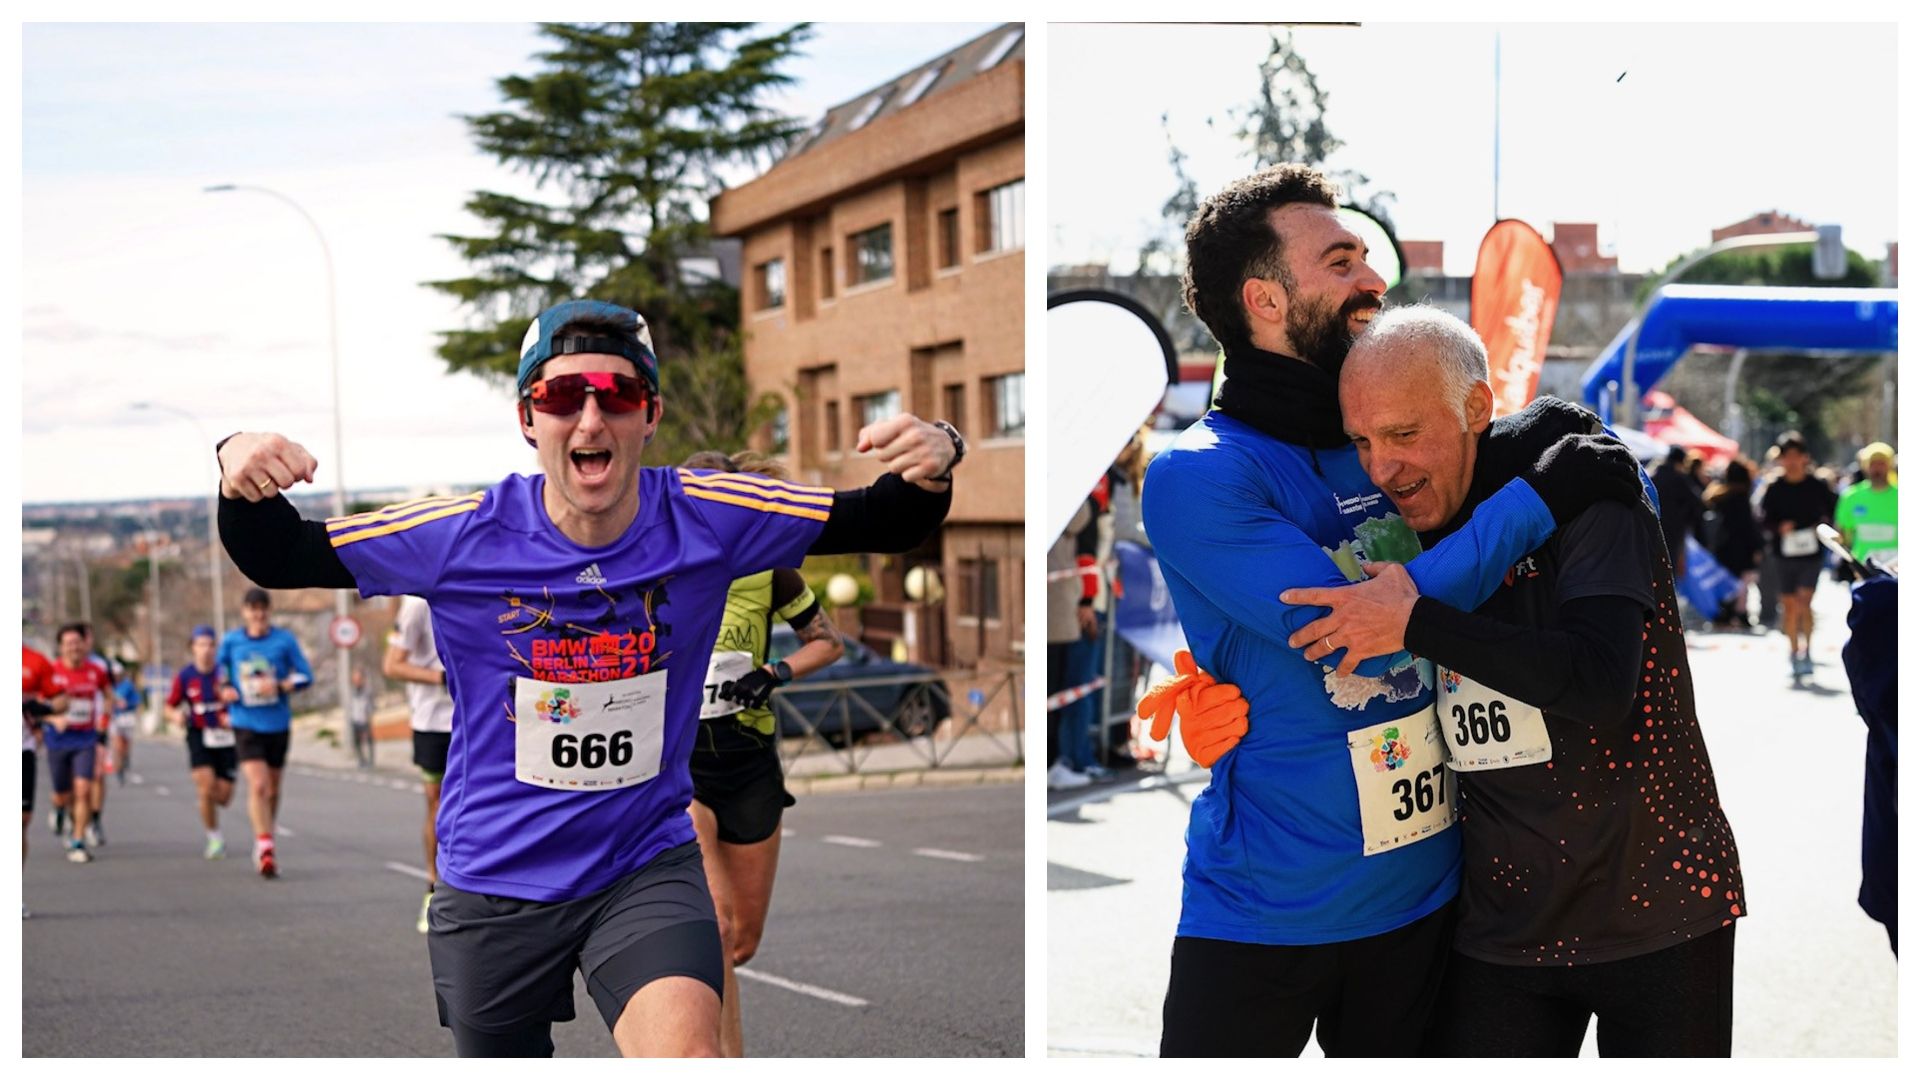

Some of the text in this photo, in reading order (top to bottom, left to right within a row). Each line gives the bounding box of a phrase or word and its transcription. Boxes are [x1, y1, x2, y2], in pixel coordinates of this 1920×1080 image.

[575, 574, 608, 585] adidas
[497, 608, 521, 624] START
[531, 637, 588, 658] BMW
[623, 631, 655, 656] 20
[532, 655, 589, 671] BERLIN
[622, 655, 651, 678] 21
[533, 667, 622, 684] MARATHON
[1452, 700, 1511, 747] 366
[551, 729, 633, 769] 666
[1391, 762, 1445, 822] 367
